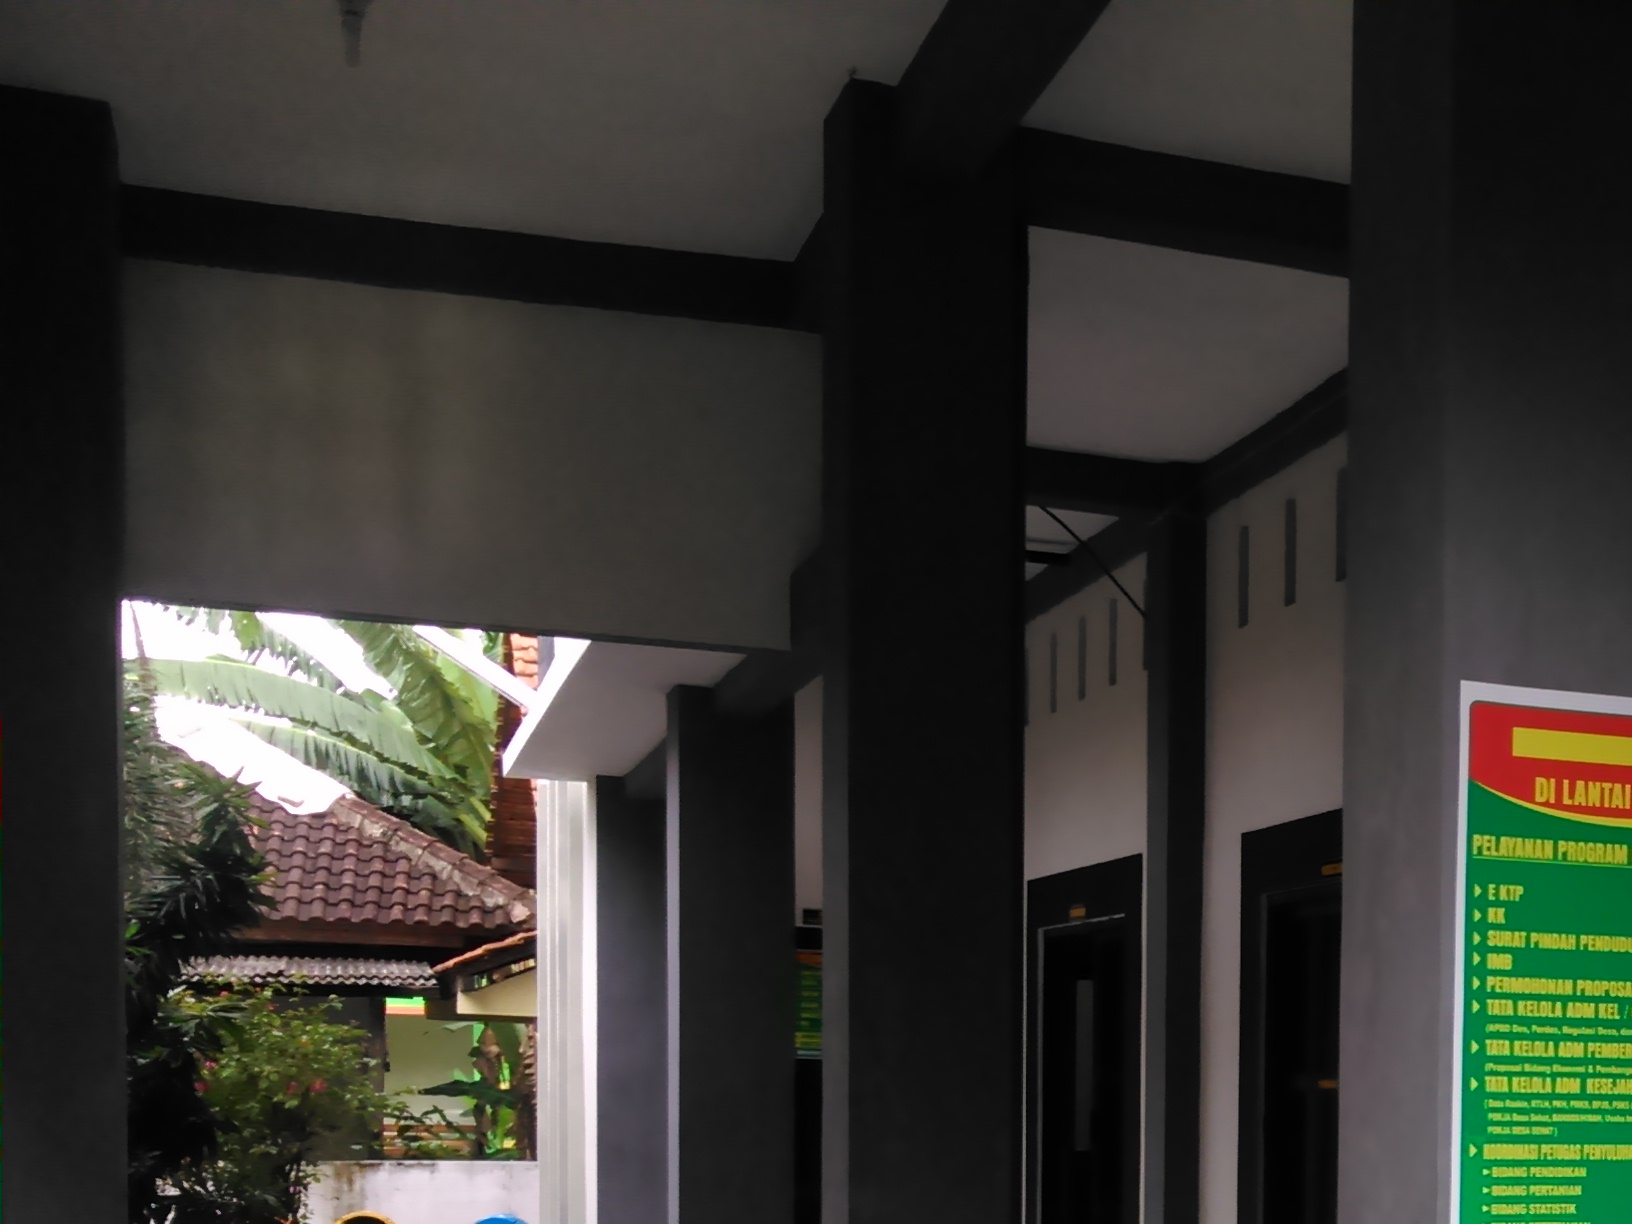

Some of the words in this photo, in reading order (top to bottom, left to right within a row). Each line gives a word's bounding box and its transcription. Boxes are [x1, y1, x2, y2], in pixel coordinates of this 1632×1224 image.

[1535, 777, 1555, 803] DI
[1562, 779, 1631, 809] LANTAI
[1472, 834, 1554, 859] PELAYANAN
[1557, 840, 1629, 865] PROGRAM
[1488, 884, 1496, 900] E
[1499, 884, 1524, 901] KTP
[1487, 907, 1505, 923] KK
[1487, 930, 1527, 947] SURAT
[1530, 932, 1577, 950] PINDAH
[1486, 976, 1574, 995] PERMOHONAN
[1486, 999, 1514, 1016] TATA
[1516, 1000, 1563, 1017] KELOLA
[1565, 1002, 1597, 1018] ADM
[1485, 1039, 1511, 1056] TATA
[1513, 1040, 1555, 1057] KELOLA
[1557, 1041, 1586, 1057] ADM
[1485, 1076, 1510, 1092] TATA
[1511, 1077, 1554, 1093] KELOLA
[1554, 1077, 1581, 1094] ADM
[1540, 1144, 1583, 1160] PETUGAS
[1491, 1167, 1529, 1177] BIDANG
[1529, 1167, 1586, 1177] PENDIDIKAN
[1490, 1185, 1529, 1196] BIDANG
[1528, 1185, 1582, 1196] PERTANIAN
[1490, 1204, 1528, 1214] BIDANG
[1528, 1203, 1576, 1214] STATISTIK
